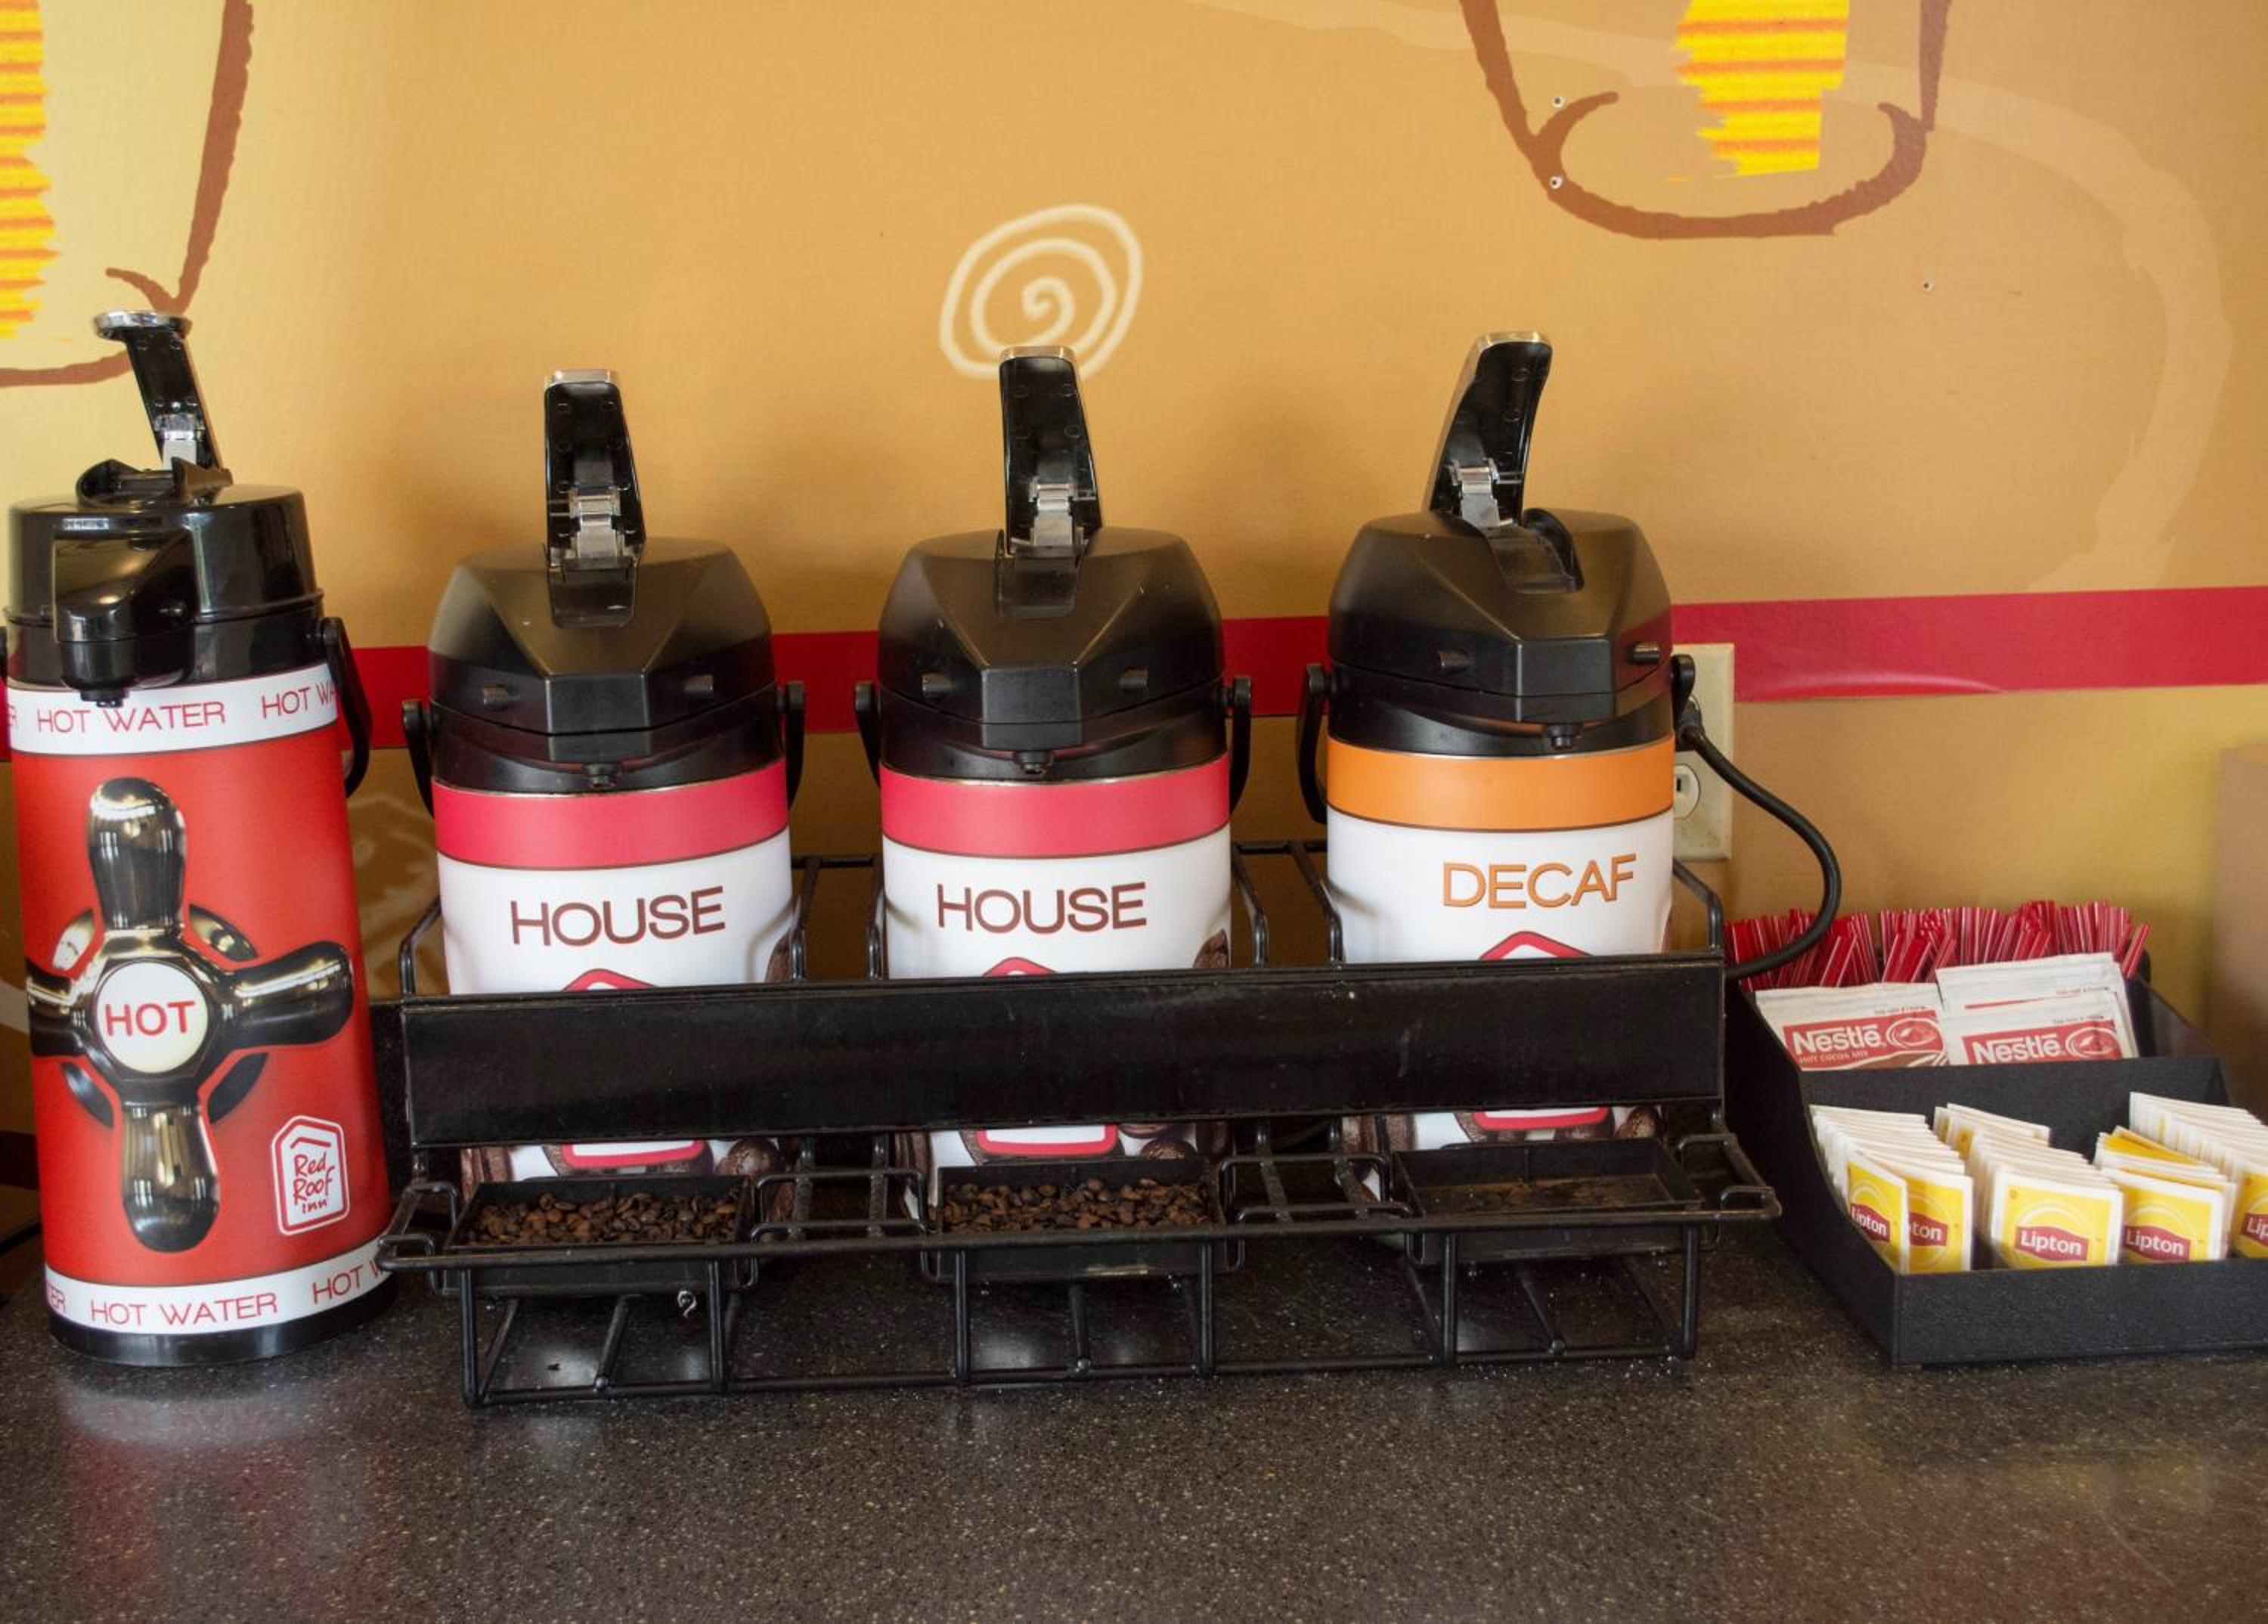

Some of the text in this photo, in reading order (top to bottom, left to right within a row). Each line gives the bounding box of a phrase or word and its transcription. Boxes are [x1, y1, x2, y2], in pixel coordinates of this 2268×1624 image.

[36, 708, 91, 733] HOT
[102, 701, 226, 733] WATER
[262, 686, 311, 720] HOT
[1442, 854, 1637, 908] DECAF
[510, 885, 726, 947] HOUSE
[937, 882, 1147, 934] HOUSE
[104, 1000, 195, 1037] HOT
[293, 1151, 327, 1178] Red
[293, 1165, 335, 1206] Roof
[1852, 1206, 1888, 1237] Lipton
[1907, 1220, 1941, 1241] ton
[2247, 1215, 2268, 1241] Lip
[2020, 1229, 2083, 1256] Lipton
[2126, 1229, 2185, 1257] Lipton
[312, 1263, 364, 1304] HOT
[89, 1291, 279, 1327] HOT WATER
